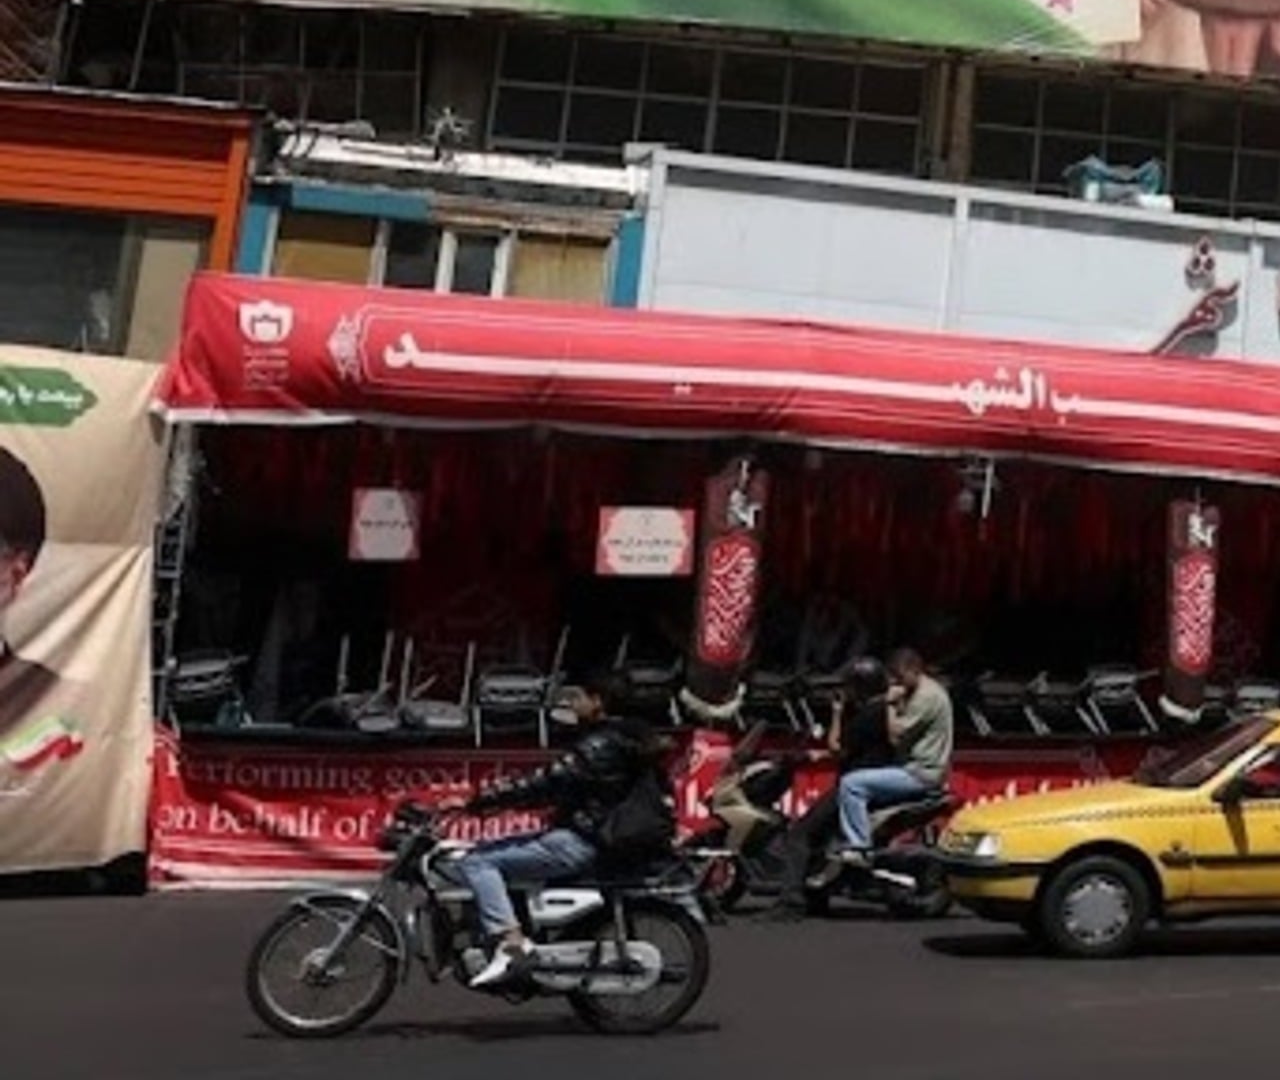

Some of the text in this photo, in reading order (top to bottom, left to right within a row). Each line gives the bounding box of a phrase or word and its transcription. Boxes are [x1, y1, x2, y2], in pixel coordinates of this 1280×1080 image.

[381, 759, 471, 800] good
[208, 802, 327, 838] behalf
[333, 809, 377, 840] of
